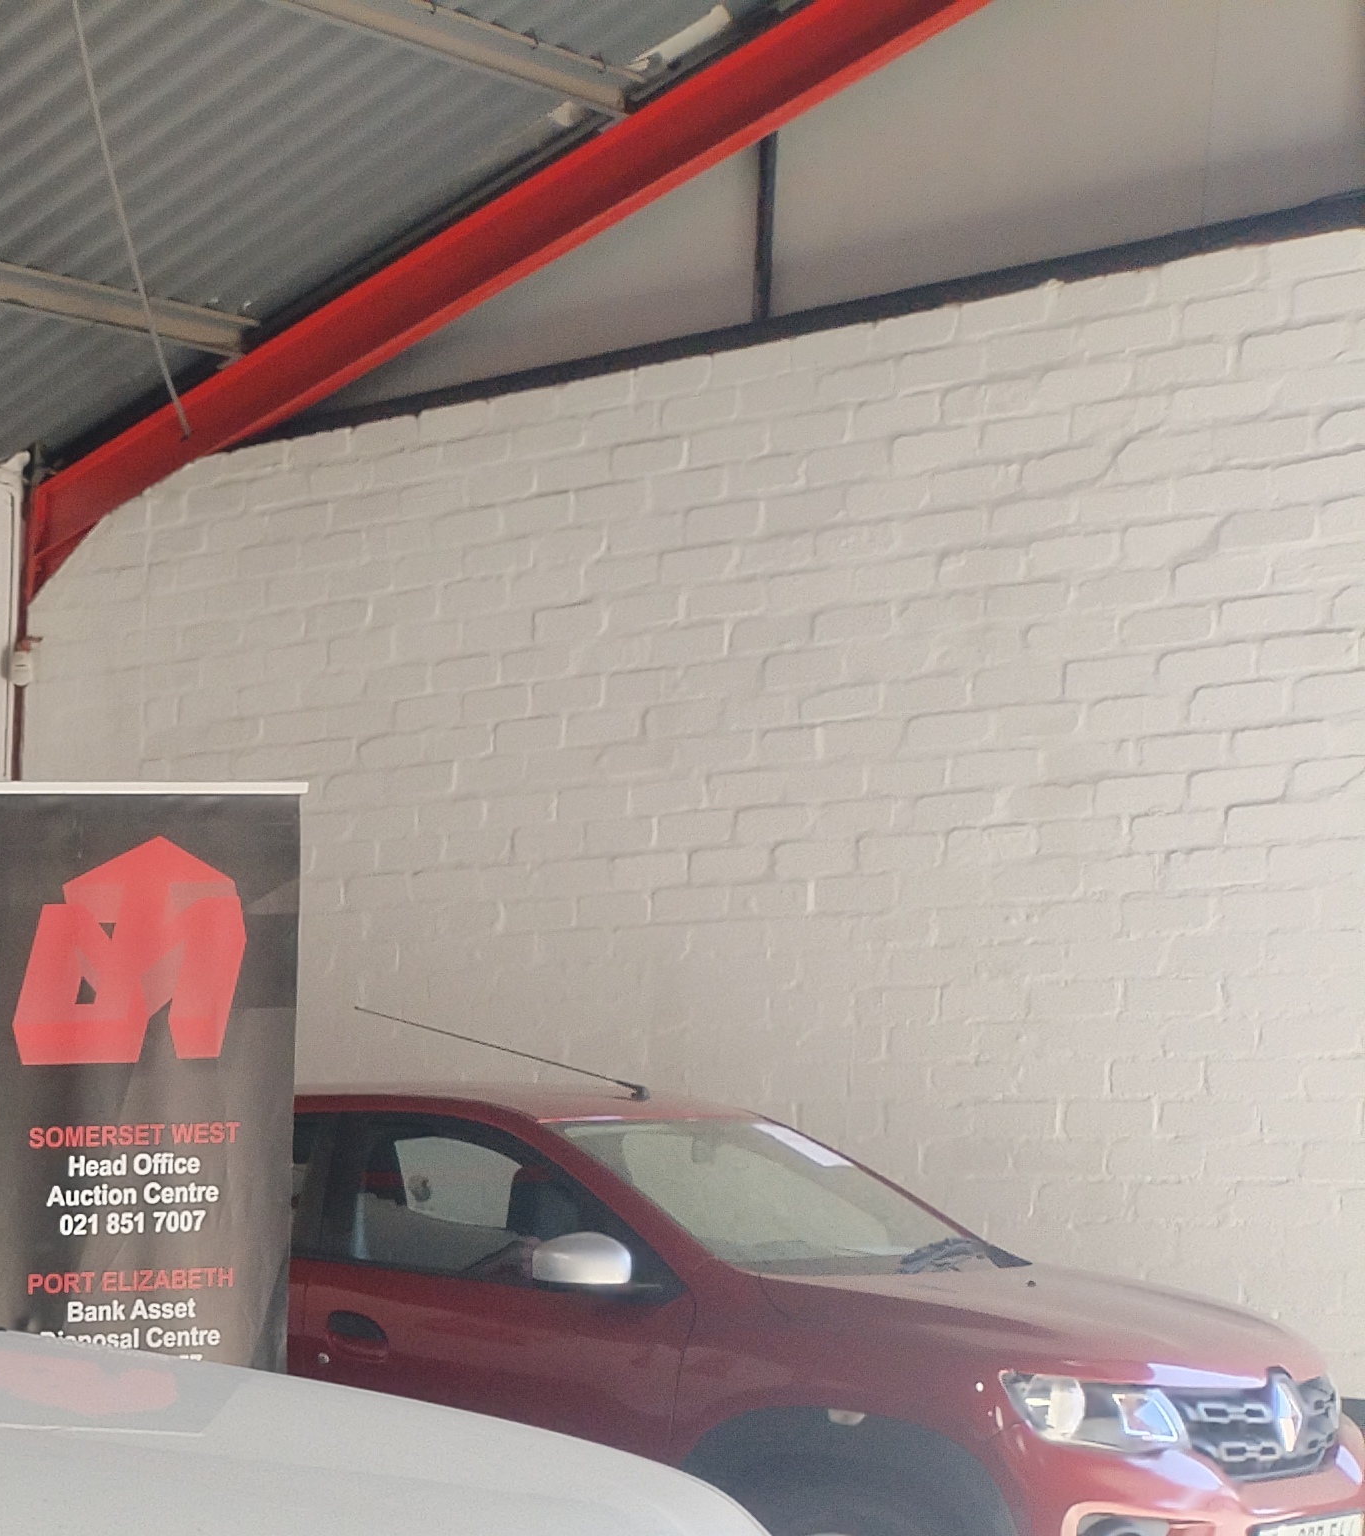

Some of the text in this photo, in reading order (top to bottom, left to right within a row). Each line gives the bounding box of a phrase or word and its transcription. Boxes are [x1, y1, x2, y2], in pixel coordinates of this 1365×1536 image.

[29, 1121, 241, 1149] SOMERSET WEST
[67, 1152, 201, 1178] Head Office
[46, 1181, 220, 1208] Auction Centre
[59, 1209, 207, 1236] 021 851 7007
[27, 1266, 235, 1295] PORT ELIZABETH
[67, 1297, 197, 1323] Bank Asset
[145, 1326, 221, 1348] Centre
